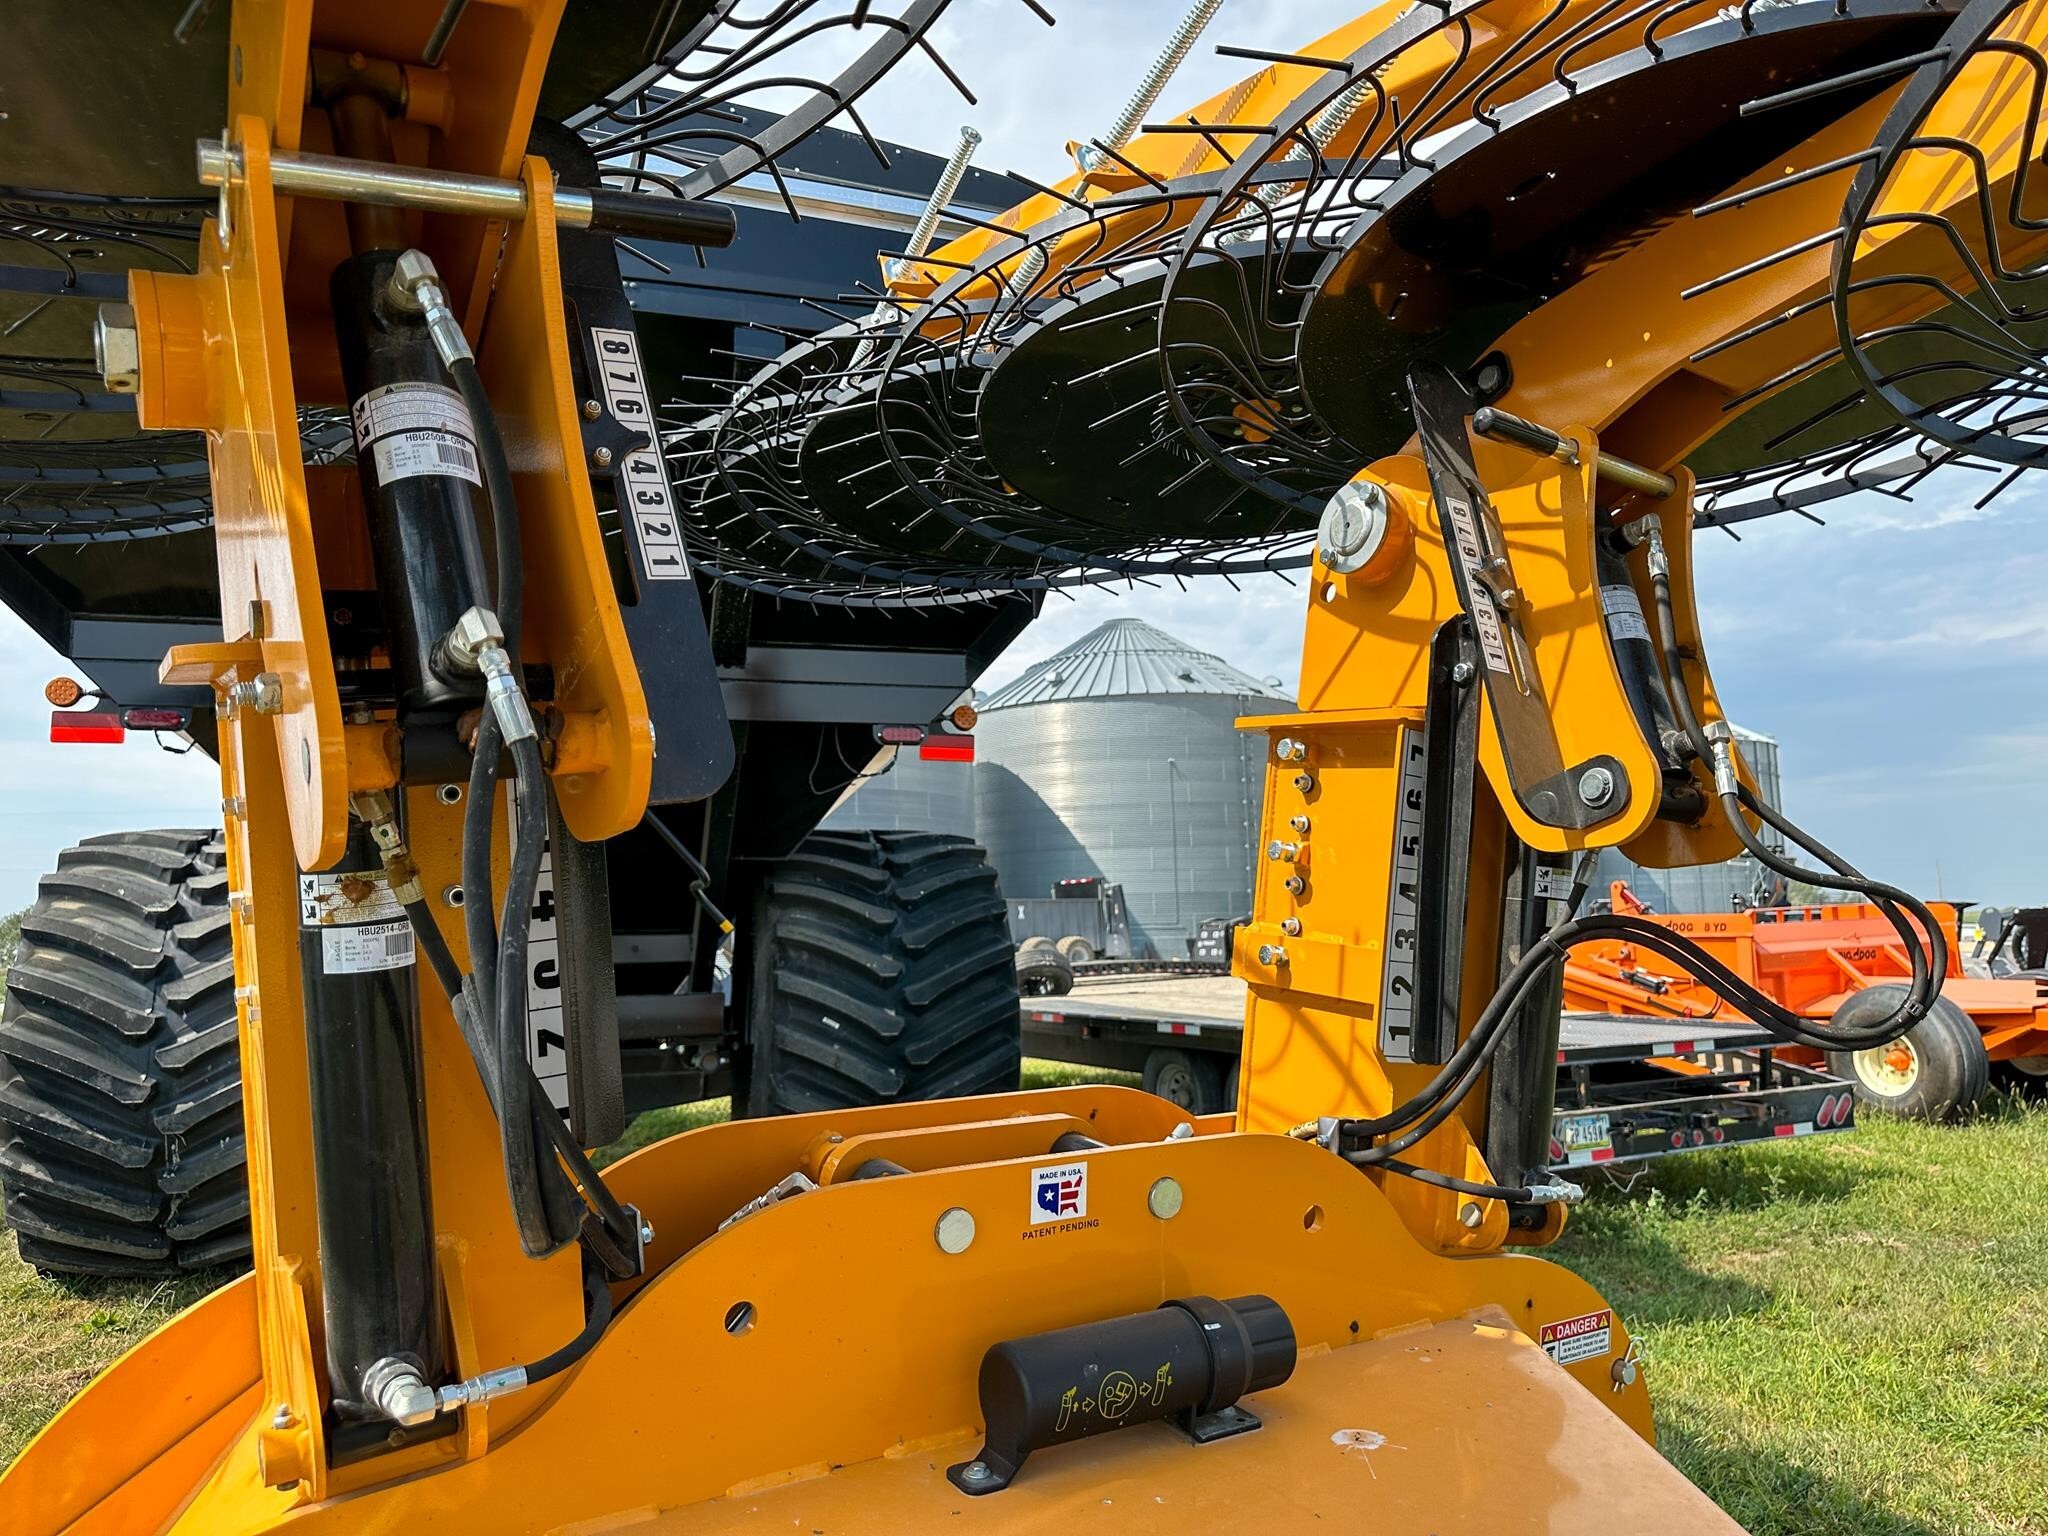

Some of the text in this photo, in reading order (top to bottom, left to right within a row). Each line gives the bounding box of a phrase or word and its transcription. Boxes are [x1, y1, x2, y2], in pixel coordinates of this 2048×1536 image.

[602, 340, 680, 566] 8 7 6 4 3 2 1
[1453, 505, 1467, 518] 8
[1462, 546, 1477, 558] 6
[1479, 608, 1493, 621] 3
[1484, 630, 1498, 642] 2
[1039, 1171, 1059, 1180] MADE
[1059, 1169, 1067, 1178] IN
[1022, 1219, 1099, 1241] PATENT PENDING
[1556, 1316, 1598, 1339] DANGER
